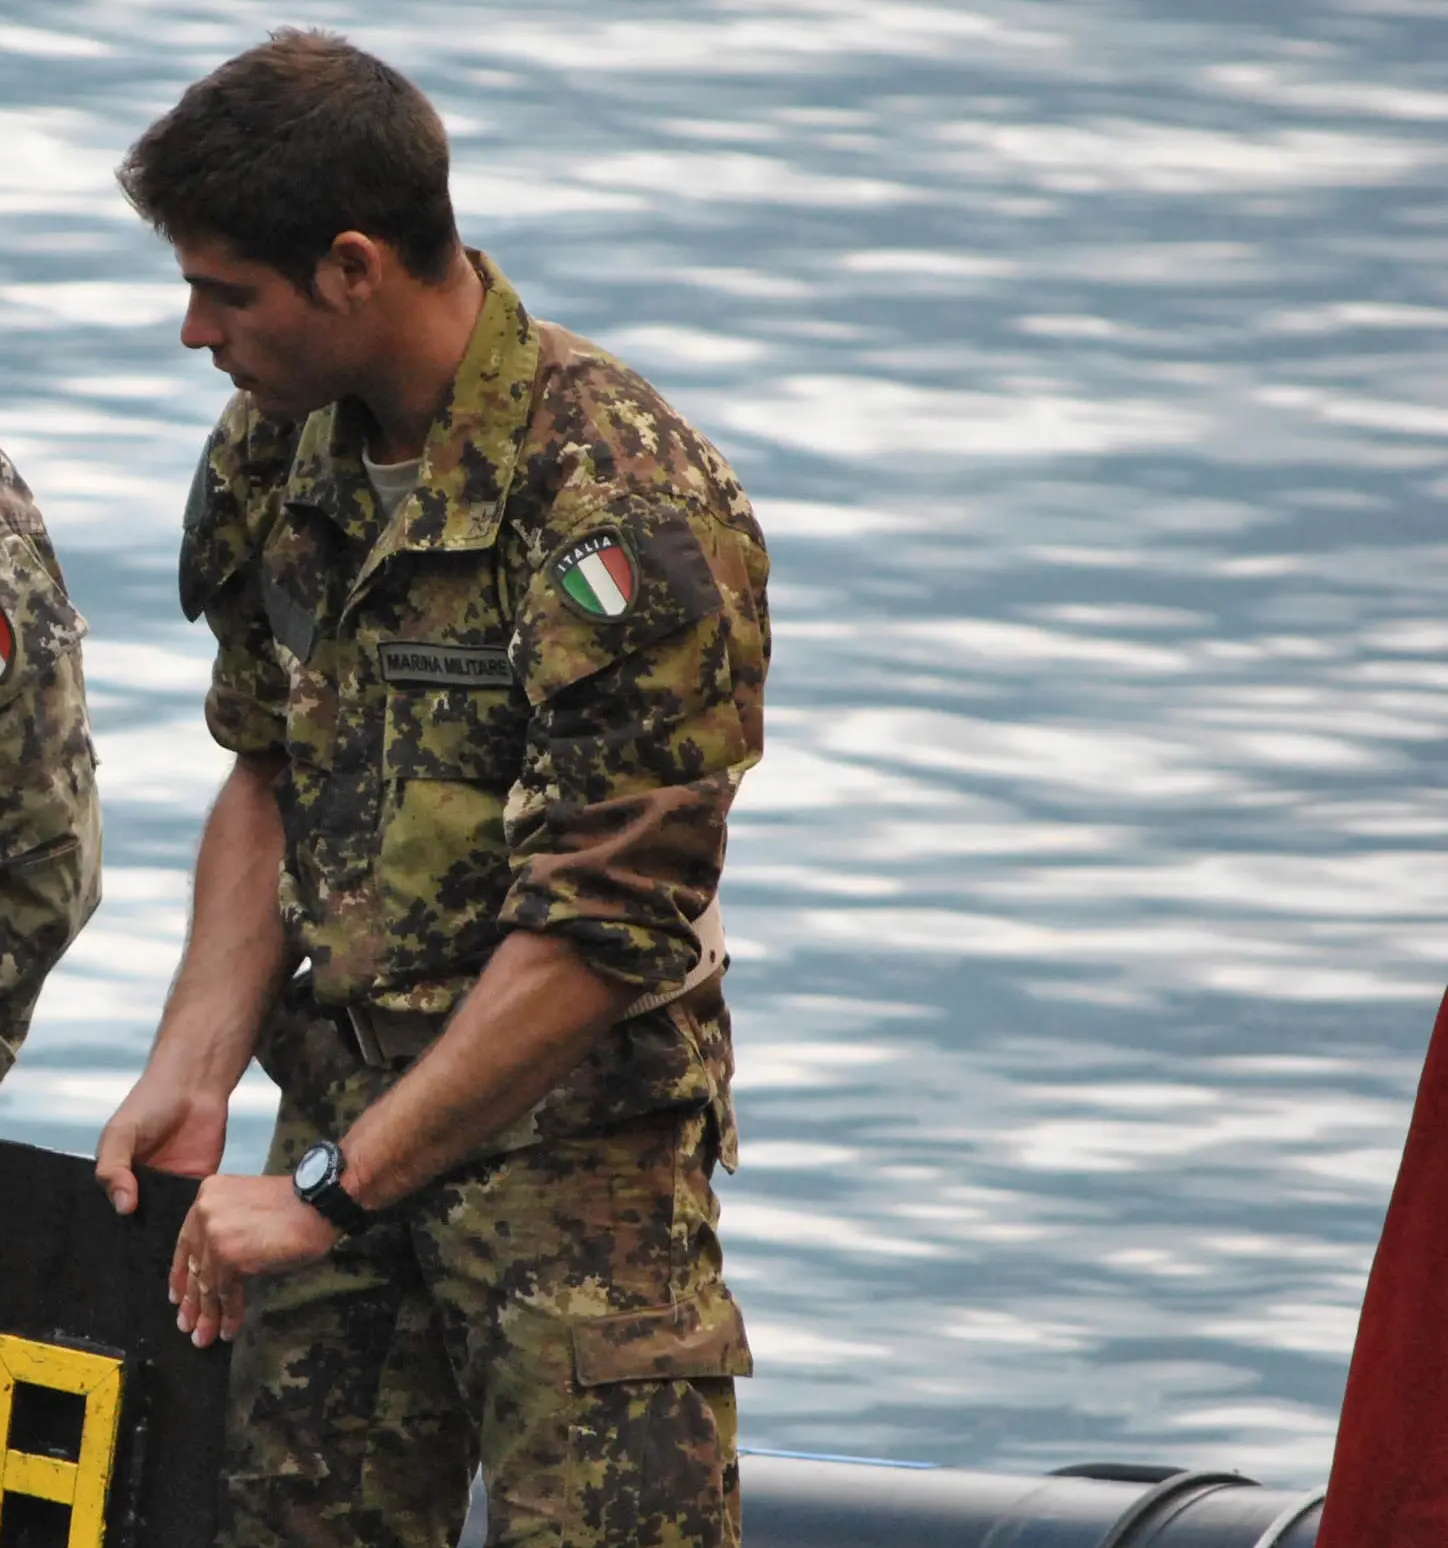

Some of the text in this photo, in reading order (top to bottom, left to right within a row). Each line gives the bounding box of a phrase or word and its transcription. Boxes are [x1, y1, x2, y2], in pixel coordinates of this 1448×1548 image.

[557, 535, 613, 573] ITALIA
[387, 653, 509, 677] MARINA MILITARE
